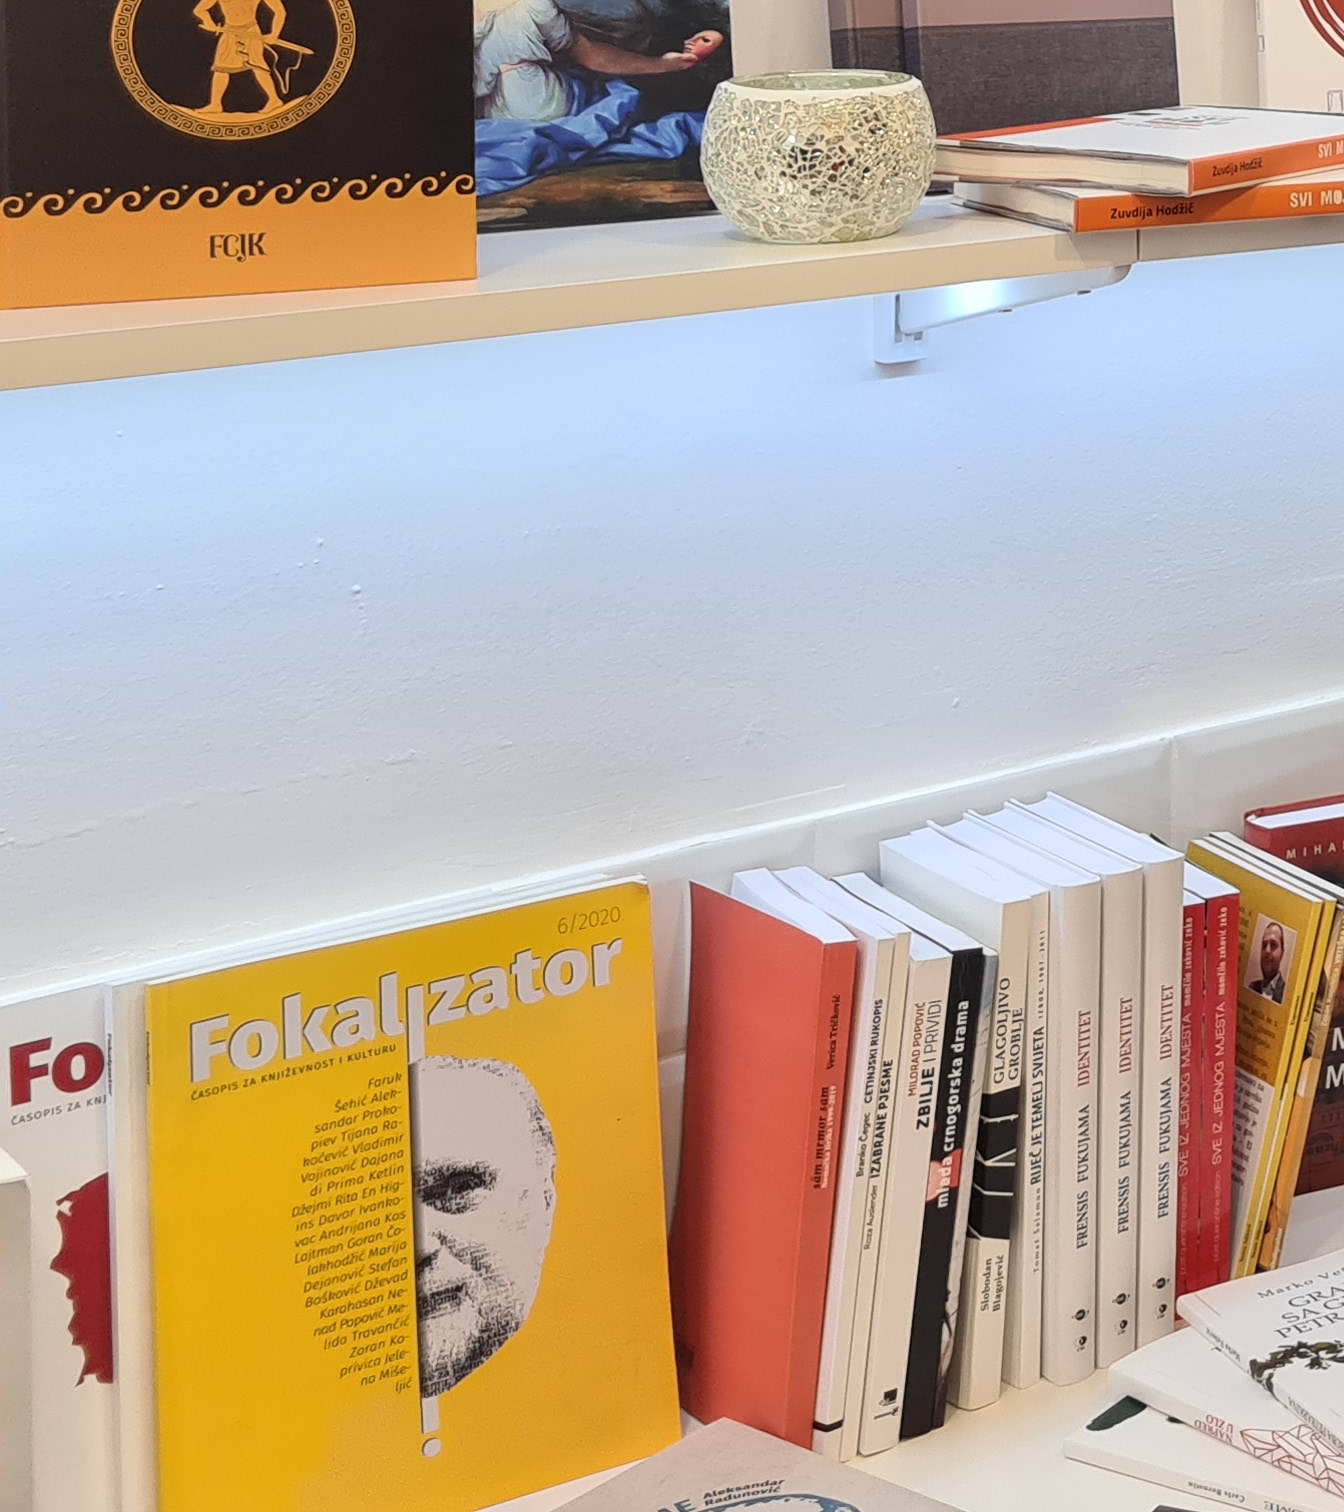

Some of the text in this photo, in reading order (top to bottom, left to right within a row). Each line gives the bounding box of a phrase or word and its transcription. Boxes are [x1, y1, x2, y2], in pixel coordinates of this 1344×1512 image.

[1317, 141, 1332, 159] SVI
[1110, 201, 1195, 220] Zuvdija Hodžić
[556, 906, 622, 936] 6/2020
[189, 935, 624, 1084] Fokalizator
[924, 999, 942, 1055] PRIVIDI
[1215, 1001, 1226, 1057] MJESTA
[908, 1001, 926, 1097] MILORAD POPOVIĆ
[994, 977, 1011, 1085] GLAGOLJIVO
[1009, 1008, 1024, 1080] GROBLJE
[190, 1078, 239, 1102] ČASOPIS
[242, 1074, 257, 1090] ZA
[260, 1055, 336, 1085] KNJIŽEVNOST
[346, 1043, 398, 1066] KULTURU
[368, 1072, 403, 1090] Faruk
[856, 999, 883, 1178] Branko Čegec CETINJSKI RUKOPIS
[1212, 1060, 1224, 1119] JEDNOG
[334, 1089, 401, 1113] Šehić Alek-
[916, 1067, 935, 1130] ZBILJE
[938, 1000, 970, 1208] mlada crnogorska drama
[314, 1105, 401, 1134] sandar Proko-
[1076, 1010, 1092, 1250] FRENSIS FUKUJAMA IDENTITET
[1212, 1120, 1223, 1134] IZ
[302, 1135, 404, 1169] kočević Vladimir
[864, 1228, 873, 1250] Roza
[870, 1112, 887, 1179] IZABRANE
[879, 1059, 893, 1109] PJESME
[1212, 1137, 1222, 1165] SVE
[303, 1255, 408, 1294] Dejanović Stefan
[305, 1270, 408, 1309] Bošković Dževad
[980, 1258, 993, 1312] Slobodan
[992, 1254, 1004, 1312] Blagojević
[1257, 1279, 1314, 1299] Marko
[323, 1316, 410, 1351] lida Travančić
[1281, 1307, 1320, 1323] SA
[701, 1478, 785, 1501] Aleksandar
[704, 1485, 781, 1508] Radunović
